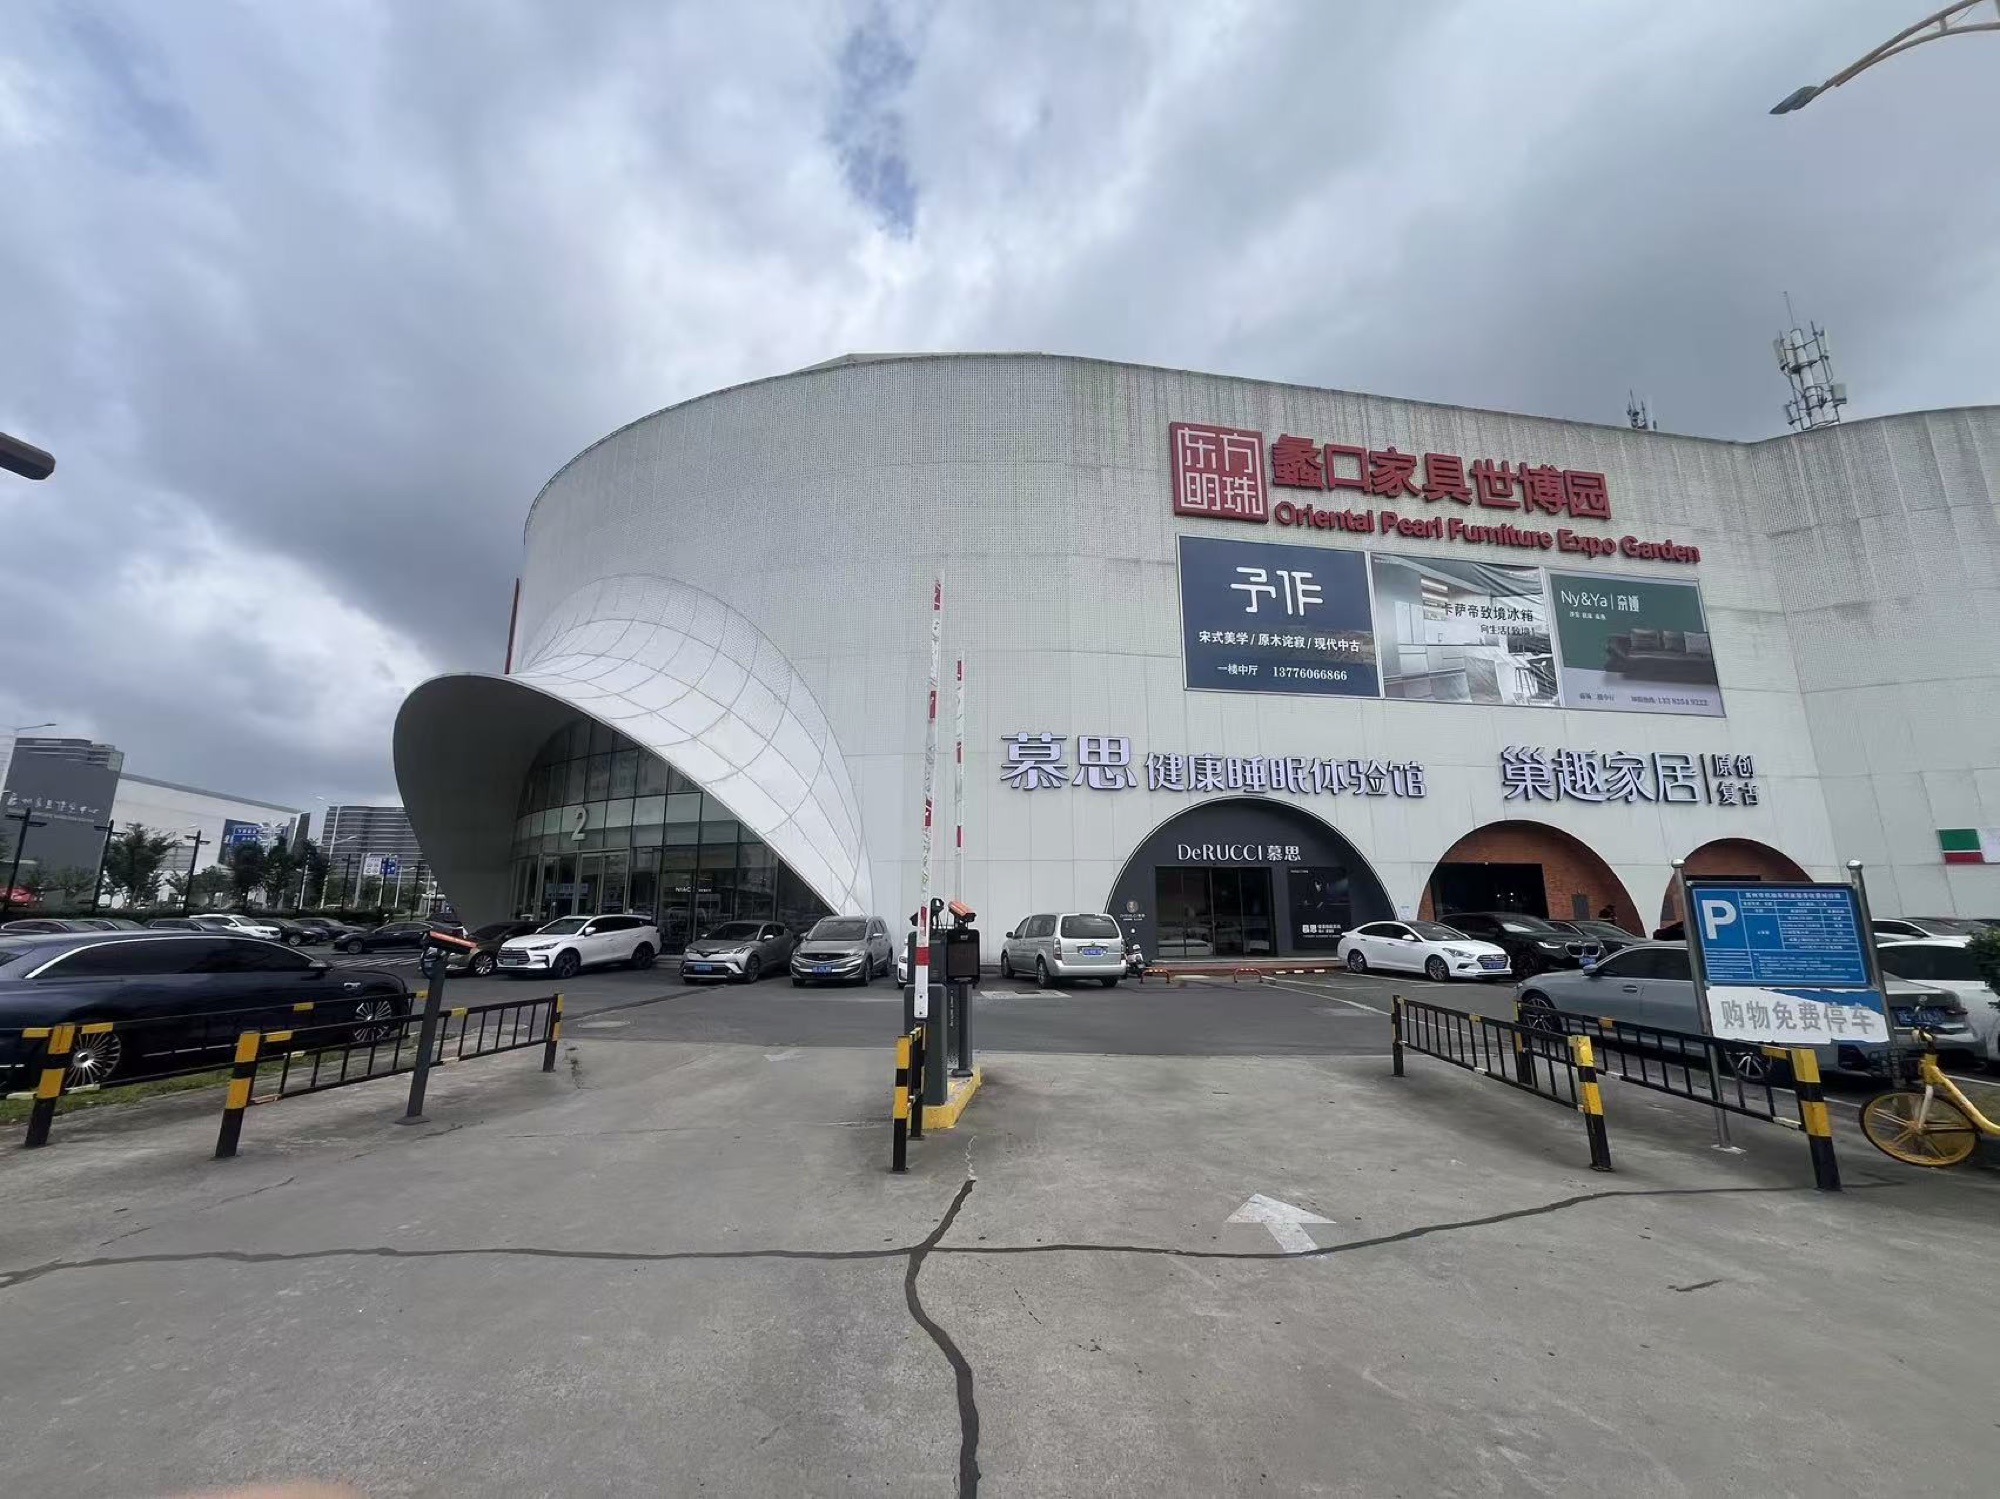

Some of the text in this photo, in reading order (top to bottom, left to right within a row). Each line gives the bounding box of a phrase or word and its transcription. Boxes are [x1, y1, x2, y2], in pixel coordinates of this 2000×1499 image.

[1184, 427, 1256, 474] 东方
[1186, 471, 1263, 514] 明珠
[1271, 433, 1612, 520] 蠡口家具世博园
[1274, 501, 1701, 563] Oriental Pearl Furniture Expo Garden
[1560, 590, 1608, 607] Ny&Ya
[1272, 666, 1348, 681] 13776066866
[1000, 731, 1427, 799] 慕思 健康睡眠体验馆
[1500, 744, 1698, 803] 巢趣家居
[1712, 753, 1756, 779] 原创
[1716, 781, 1759, 806] 复古
[571, 807, 589, 842] 2
[1177, 844, 1302, 861] DeRUCCI 慕思
[1701, 899, 1737, 940] P
[1720, 999, 1875, 1035] 购物免费停车
